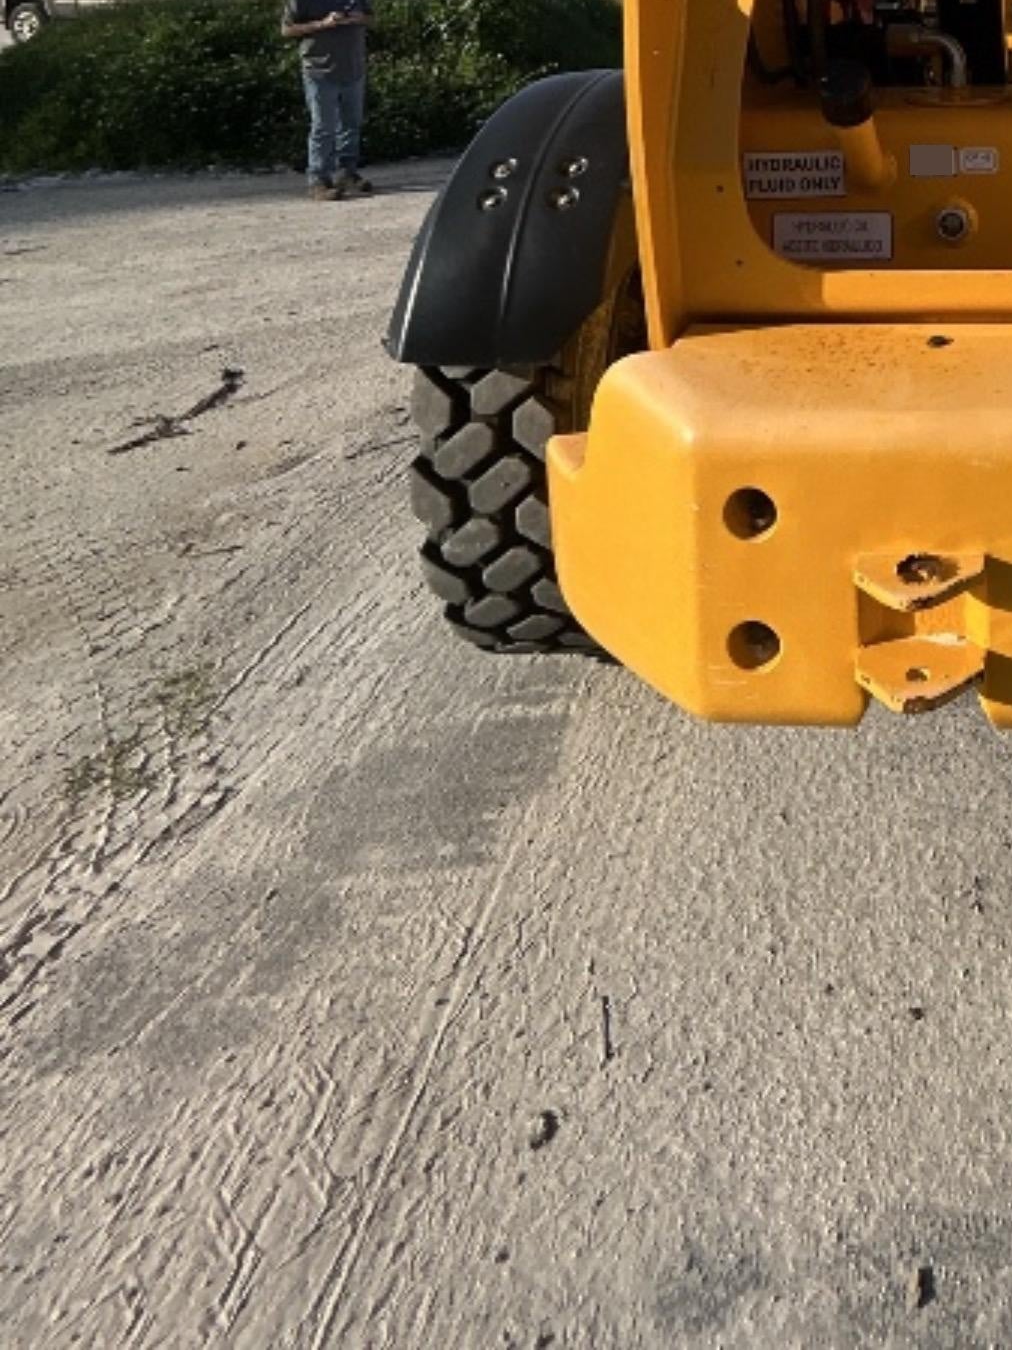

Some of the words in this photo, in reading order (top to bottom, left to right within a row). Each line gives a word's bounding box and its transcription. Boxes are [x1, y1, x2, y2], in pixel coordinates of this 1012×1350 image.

[747, 155, 841, 172] HYDRAULIC
[749, 178, 796, 193] FLUID
[799, 176, 841, 192] ONLY
